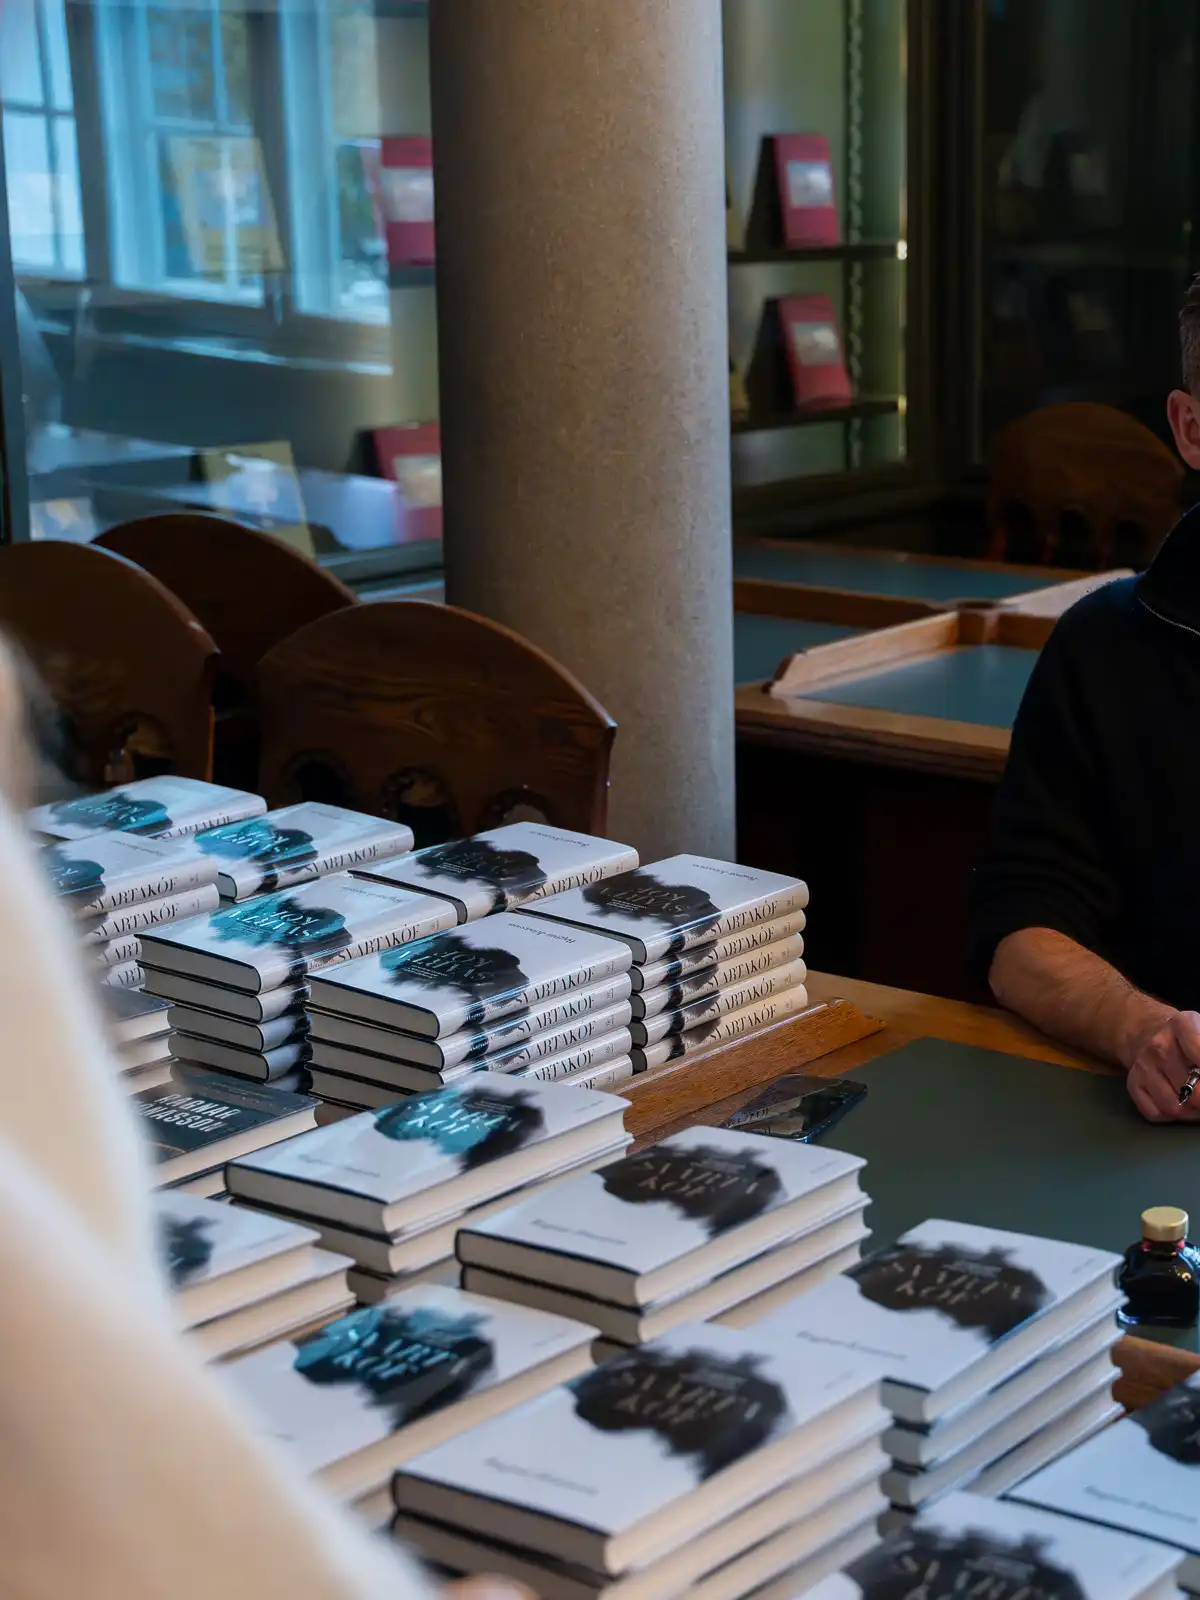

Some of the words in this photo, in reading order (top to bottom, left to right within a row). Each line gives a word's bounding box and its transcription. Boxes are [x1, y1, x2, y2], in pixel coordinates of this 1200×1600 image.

[90, 877, 180, 910] SVARTAKÓF
[710, 900, 777, 937] SVARTAKÓF
[338, 923, 420, 960] SVARTAKÓF
[707, 926, 775, 960] SVARTAKÓF
[516, 964, 595, 1004] SVARTAKÓF
[707, 951, 773, 988] SVARTAKÓF
[517, 993, 595, 1033] SVARTAKÓF
[709, 977, 775, 1017] SVARTAKÓF
[517, 1020, 596, 1060] SVARTAKÓF
[710, 1004, 777, 1040] SVARTAKÓF
[534, 1048, 595, 1080] ARTAKÓF
[154, 1093, 241, 1120] RAGNAR
